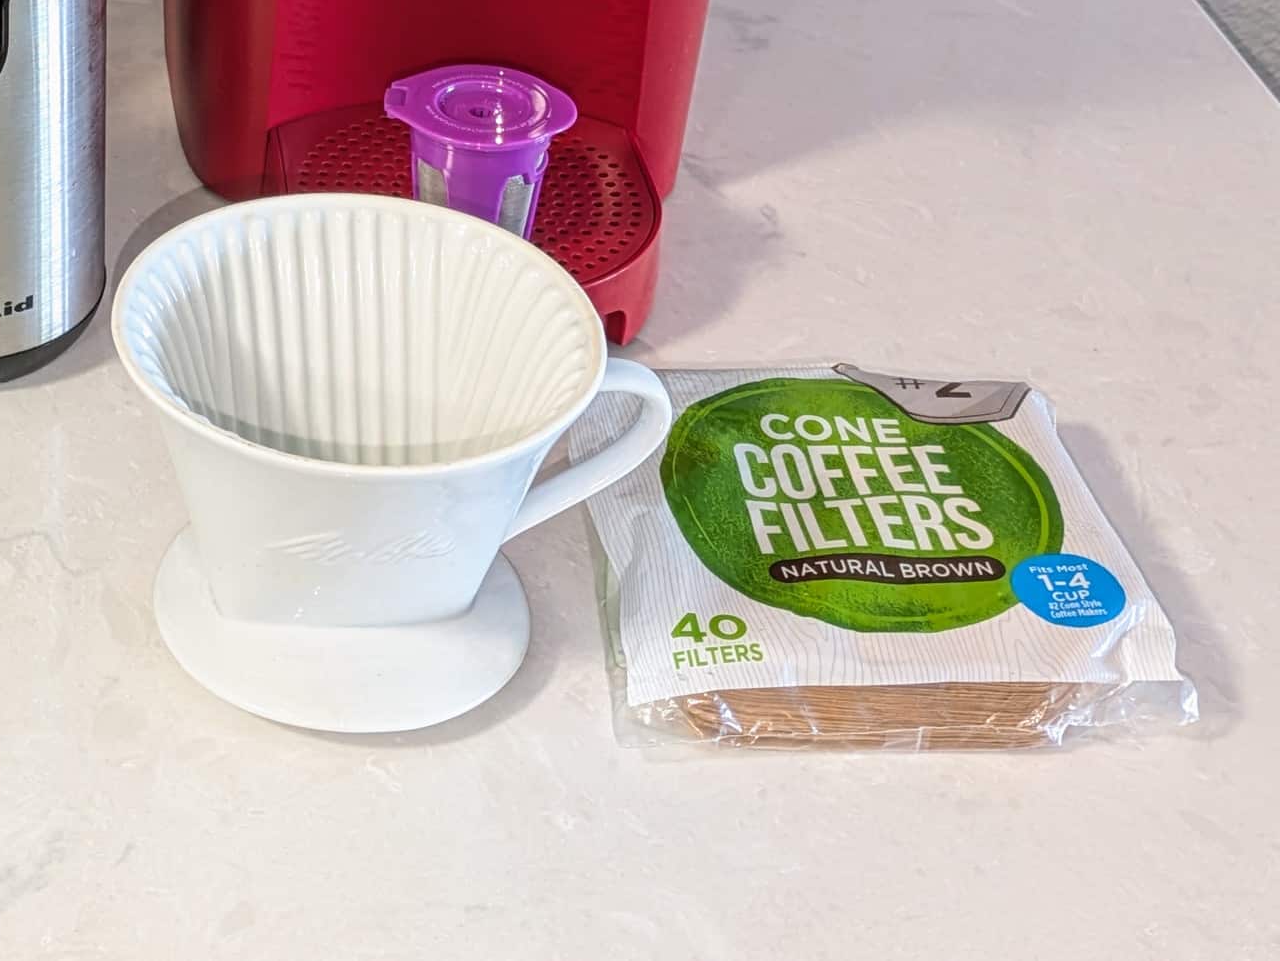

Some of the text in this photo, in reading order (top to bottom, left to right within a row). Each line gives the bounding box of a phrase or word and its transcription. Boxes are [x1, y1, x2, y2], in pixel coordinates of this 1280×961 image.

[760, 413, 908, 444] CONE
[733, 442, 965, 500] COFFEE
[744, 494, 995, 555] FILTERS
[780, 558, 995, 580] NATURAL BROWN
[1028, 563, 1089, 574] Fits Most
[1037, 571, 1091, 592] 1-4
[1052, 589, 1090, 602] CUP
[671, 612, 748, 643] 40
[672, 643, 764, 670] FILTERS
